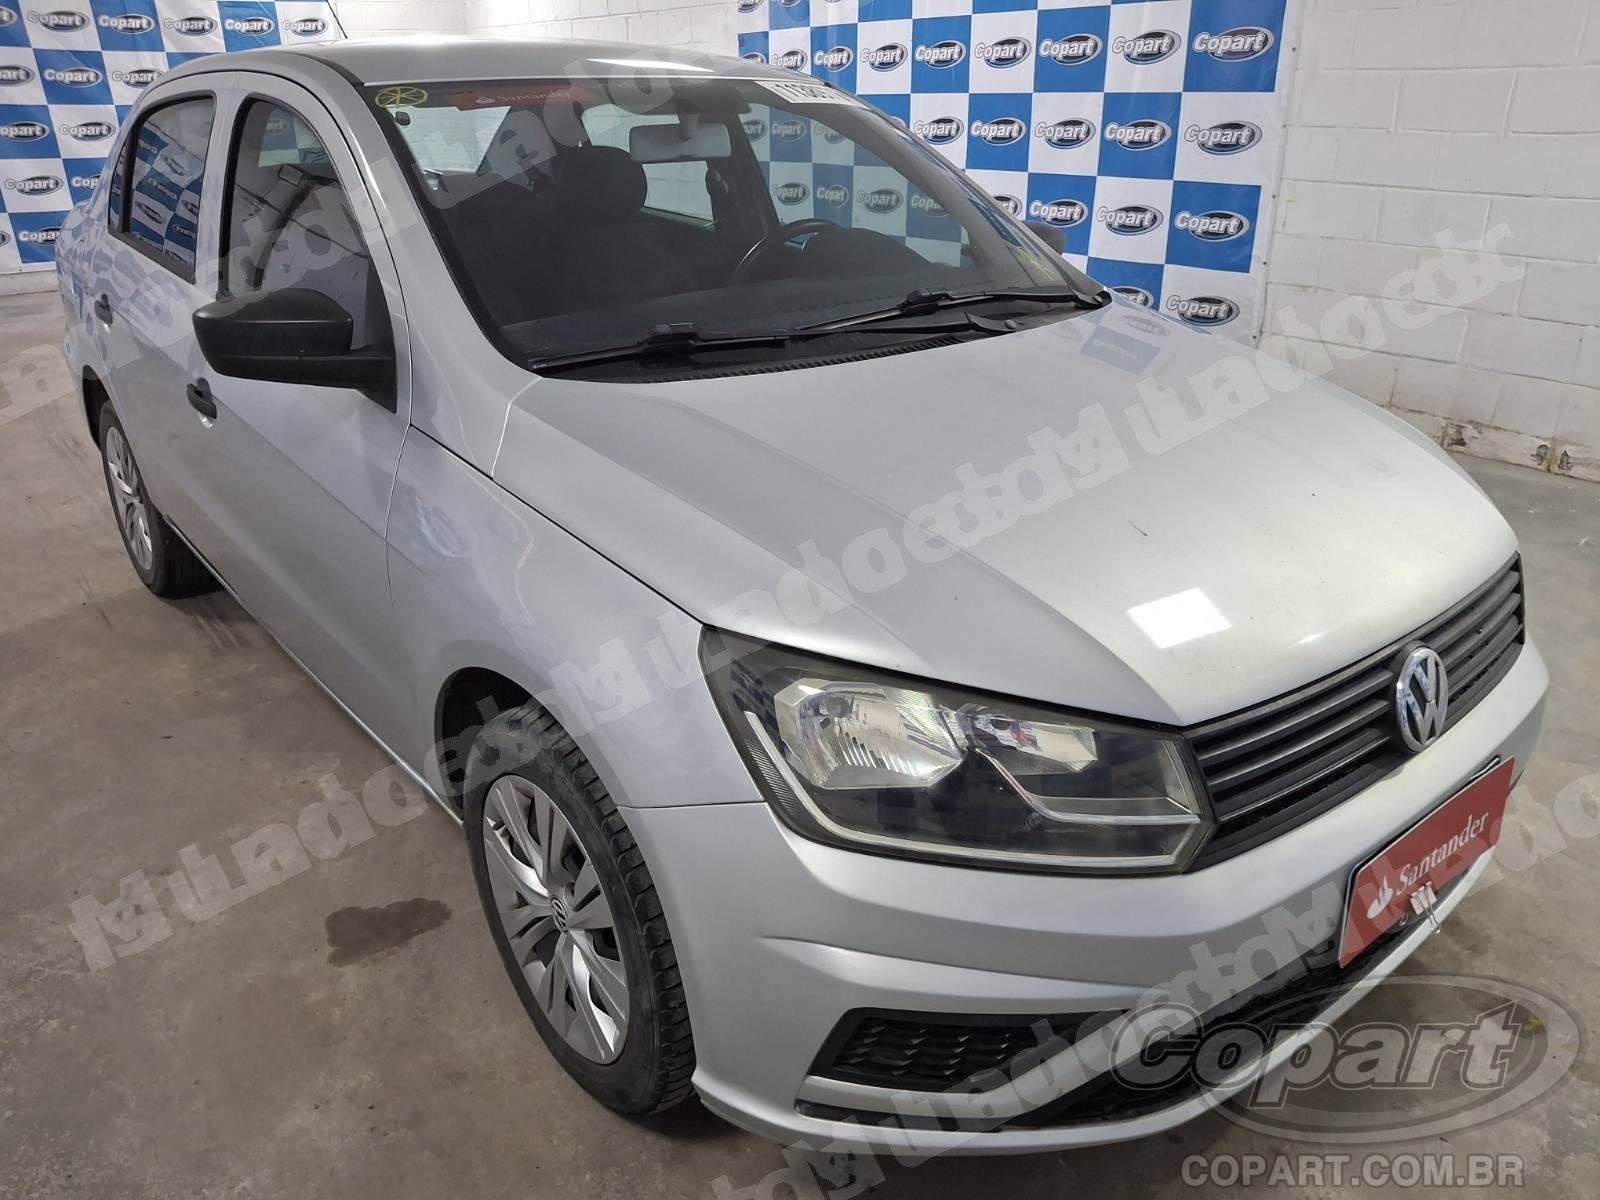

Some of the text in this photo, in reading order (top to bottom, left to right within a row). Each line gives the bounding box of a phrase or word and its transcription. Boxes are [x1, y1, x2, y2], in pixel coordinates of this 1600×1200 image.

[27, 11, 83, 28] Copart
[98, 15, 150, 30] Copart
[164, 18, 211, 33] Copart
[225, 19, 269, 32] Copart
[282, 20, 323, 32] Copart
[974, 42, 1024, 62] Copart
[1039, 38, 1095, 60] Copart
[1112, 34, 1171, 58] Copart
[1193, 31, 1265, 56] Copart
[771, 54, 803, 68] Copart
[860, 48, 903, 66] Copart
[915, 45, 961, 63] Copart
[0, 69, 26, 81] art
[43, 69, 97, 84] Copart
[112, 71, 159, 85] Copart
[0, 125, 43, 138] opart
[58, 124, 108, 138] Copart
[771, 122, 802, 138] Copart
[914, 119, 958, 139] Copart
[971, 119, 1019, 141] Copart
[1035, 121, 1088, 143] Copart
[1104, 121, 1163, 145] Copart
[1184, 125, 1251, 148] Copart
[4, 178, 57, 193] Copart
[71, 175, 100, 190] Cop
[856, 190, 897, 208] Copart
[1029, 199, 1082, 222] Copart
[1097, 205, 1154, 228] Copart
[1174, 210, 1240, 235] Copart
[1166, 294, 1229, 320] Copart
[1396, 811, 1490, 897] Santander
